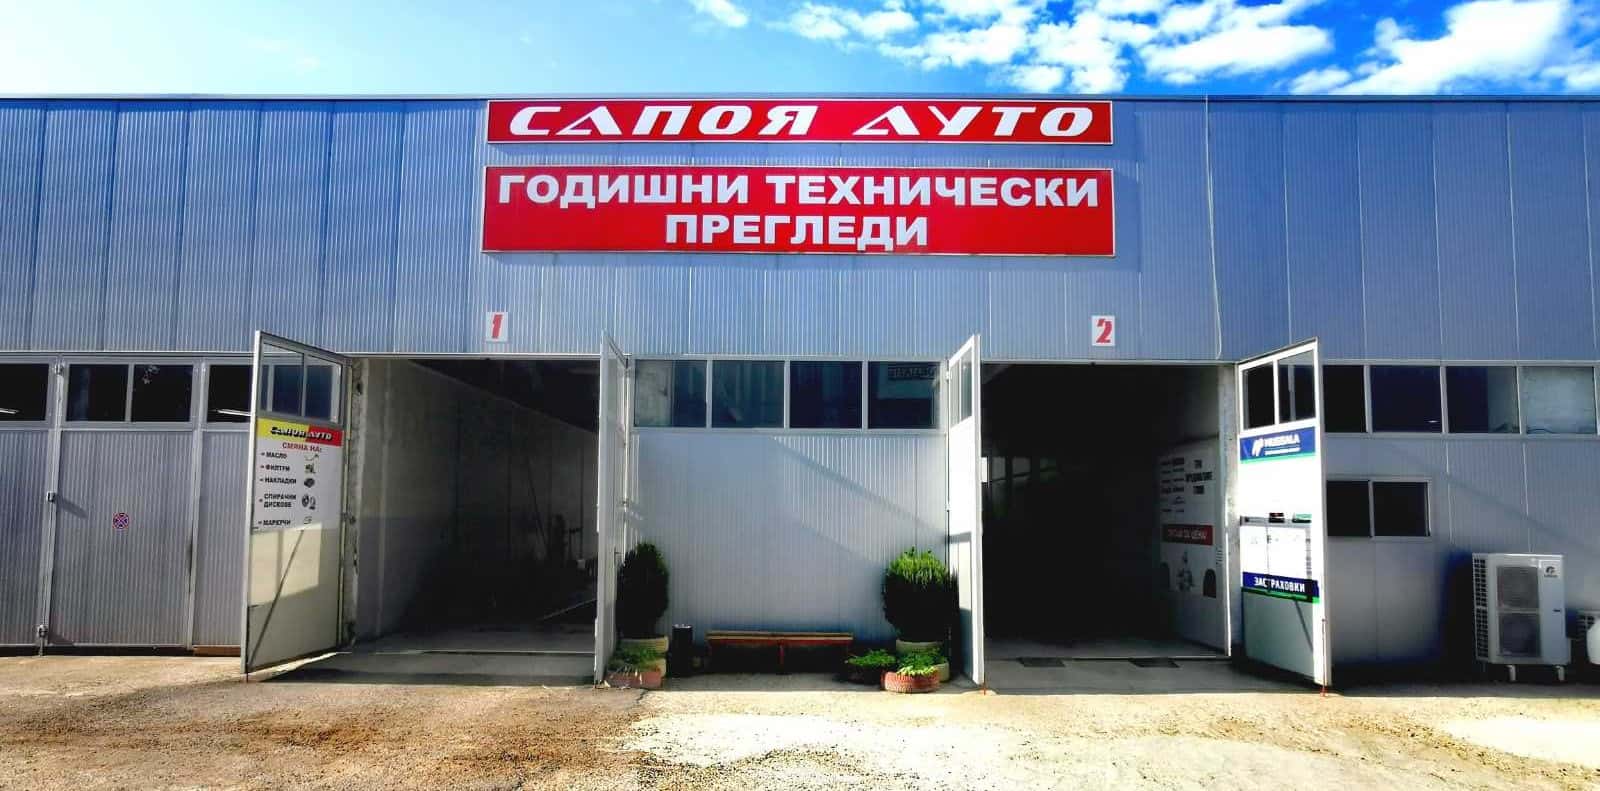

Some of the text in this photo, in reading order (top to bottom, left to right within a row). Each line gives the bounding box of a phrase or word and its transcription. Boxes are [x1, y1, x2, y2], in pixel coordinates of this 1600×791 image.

[509, 105, 1093, 137] САПОЯ АУТО
[498, 174, 1099, 209] ГОДИШНИ ТЕХНИЧЕСКИ
[665, 214, 928, 251] ПРЕГЛЕДИ
[490, 313, 504, 339] 1
[1095, 318, 1113, 343] 2
[282, 442, 308, 452] СМЯНА
